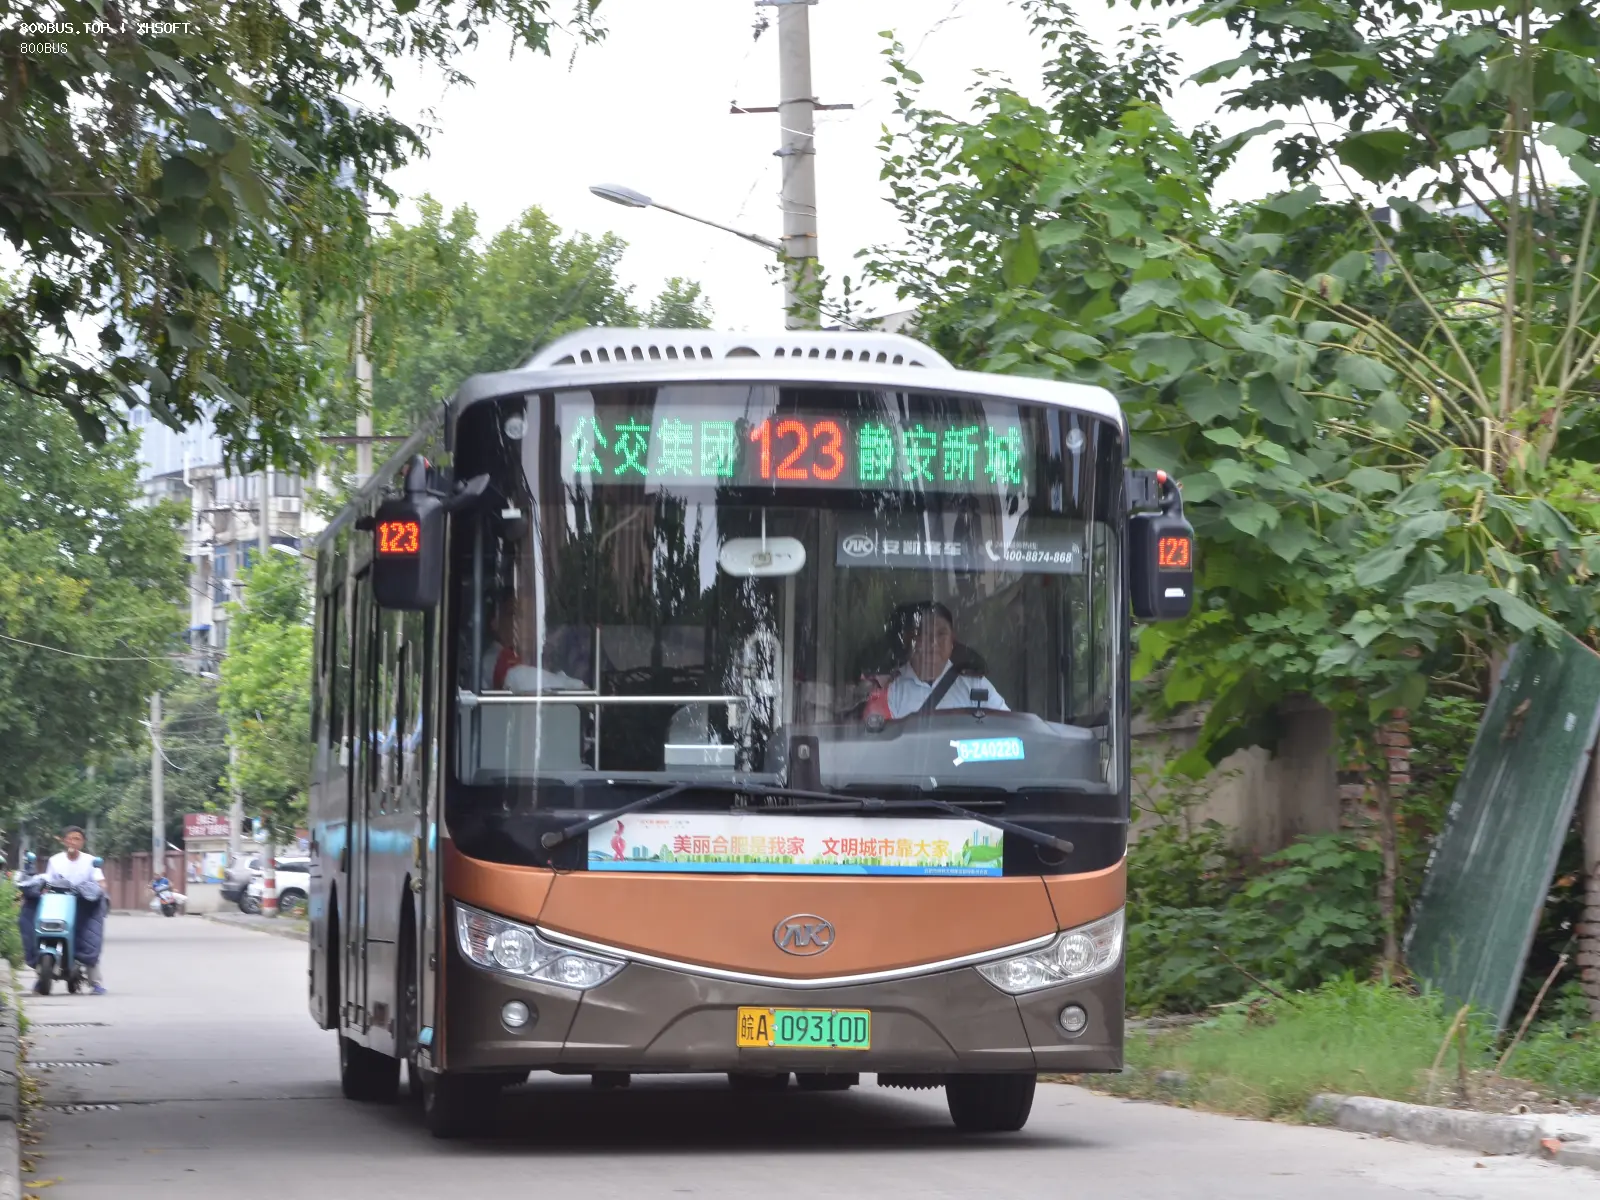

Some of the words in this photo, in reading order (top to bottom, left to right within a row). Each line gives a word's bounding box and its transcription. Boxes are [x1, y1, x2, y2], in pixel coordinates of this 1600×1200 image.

[570, 416, 734, 477] 公交集团
[750, 419, 844, 480] 123
[860, 422, 1022, 484] 静安新城
[379, 522, 419, 552] 123
[1159, 537, 1189, 566] 123
[673, 834, 805, 855] 美丽合肥是我家
[821, 837, 950, 859] 文明城市靠大家
